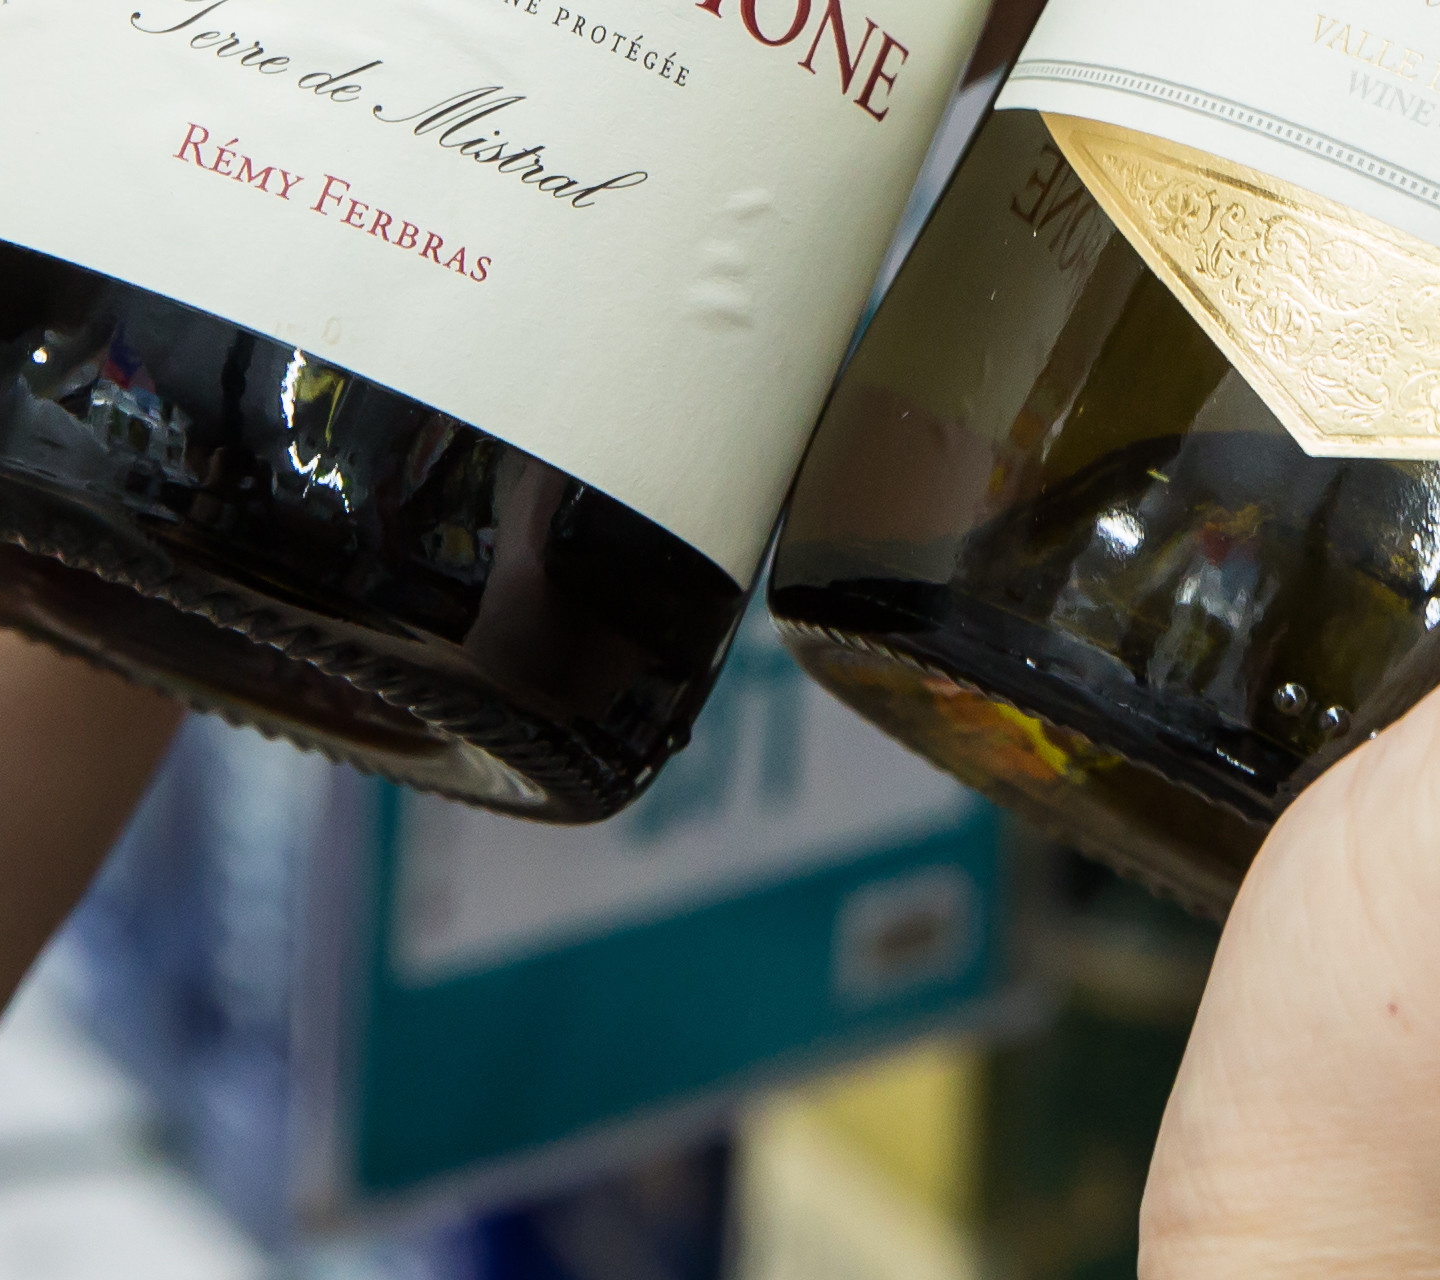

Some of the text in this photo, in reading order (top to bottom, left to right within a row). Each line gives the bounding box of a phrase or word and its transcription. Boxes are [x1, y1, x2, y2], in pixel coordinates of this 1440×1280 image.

[552, 6, 692, 88] PROTÉGÉE
[1312, 13, 1418, 83] VALLE
[297, 60, 382, 104] de
[372, 86, 649, 209] Mistral
[1346, 70, 1436, 128] WINE
